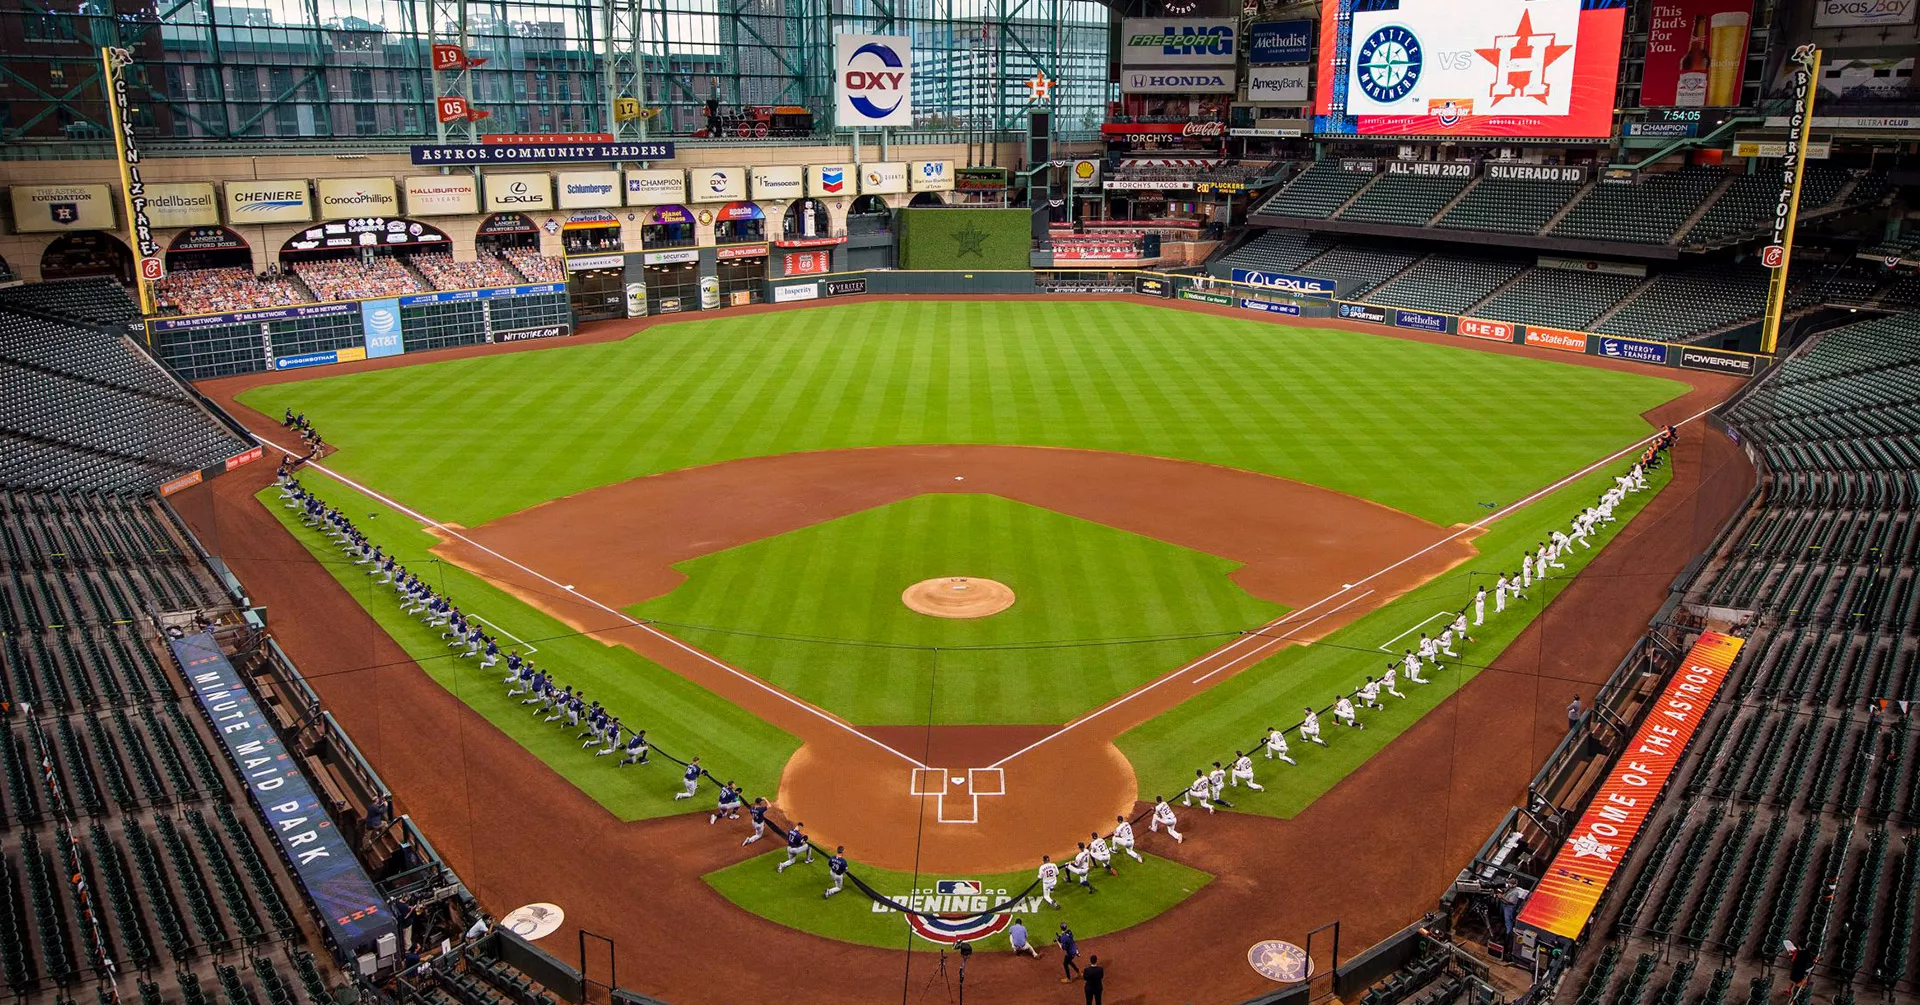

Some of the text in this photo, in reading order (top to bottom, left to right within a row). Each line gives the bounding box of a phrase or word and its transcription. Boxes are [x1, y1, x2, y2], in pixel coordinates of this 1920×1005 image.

[1165, 2, 1197, 14] ASTROS
[1653, 5, 1682, 17] This
[1824, 0, 1911, 16] Texas Bay
[1652, 18, 1687, 29] Bud's
[1128, 35, 1219, 46] FREEPORT
[1163, 26, 1233, 55] LNG
[1254, 34, 1307, 49] Methodist
[1650, 30, 1673, 41] For
[1363, 29, 1418, 57] SEATTLE
[1649, 42, 1676, 53] You.
[440, 50, 457, 62] 19
[1438, 51, 1473, 71] VS
[846, 71, 905, 90] OXY
[1150, 75, 1226, 87] HONDA
[1360, 70, 1417, 99] MARINERS
[443, 102, 462, 115] 05
[619, 103, 634, 115] 17
[1663, 110, 1701, 120] 7:54:05
[1784, 72, 1808, 166] BURGERZ
[114, 79, 139, 164] CHIKIN
[1642, 123, 1688, 132] CHAMPION
[1126, 134, 1173, 143] TORCHYS
[494, 147, 597, 159] COMMUNITY
[601, 146, 667, 157] LEADERS
[1389, 162, 1470, 176] ALL-NEW 2020
[1491, 166, 1580, 181] SILVERADO HD
[131, 166, 144, 195] IZ
[641, 179, 682, 187] CHAMPION
[410, 187, 472, 195] HALLIBURTON
[567, 183, 613, 195] Schlumberger
[31, 193, 92, 202] FOUNDATION
[235, 191, 302, 202] CHENIERE
[324, 193, 393, 206] ConocoPhillips
[495, 194, 544, 204] LEXUS
[661, 210, 682, 218] planet
[1773, 189, 1791, 244] FOUL
[134, 198, 153, 256] FARE
[663, 252, 690, 260] securian
[836, 281, 864, 290] VERITEX
[1265, 276, 1321, 291] LEXUS
[784, 287, 812, 296] Insperity
[320, 305, 347, 313] NETWORK
[192, 317, 223, 325] NETWORK
[1349, 311, 1385, 322] SPORTSNET
[1401, 313, 1440, 327] Methodist
[128, 323, 145, 331] 315
[504, 327, 559, 342] NITTOTIRE.COM
[370, 335, 399, 348] AT&T
[1623, 343, 1655, 354] ENERGY
[1622, 350, 1662, 362] TRANSFER
[1684, 353, 1750, 369] POWERADE
[1622, 761, 1654, 787] OF
[1640, 724, 1678, 757] THE
[1664, 665, 1713, 722] ASTROS
[195, 671, 330, 865] MINUTE MAID PARK
[871, 895, 1044, 913] OPENING DAY
